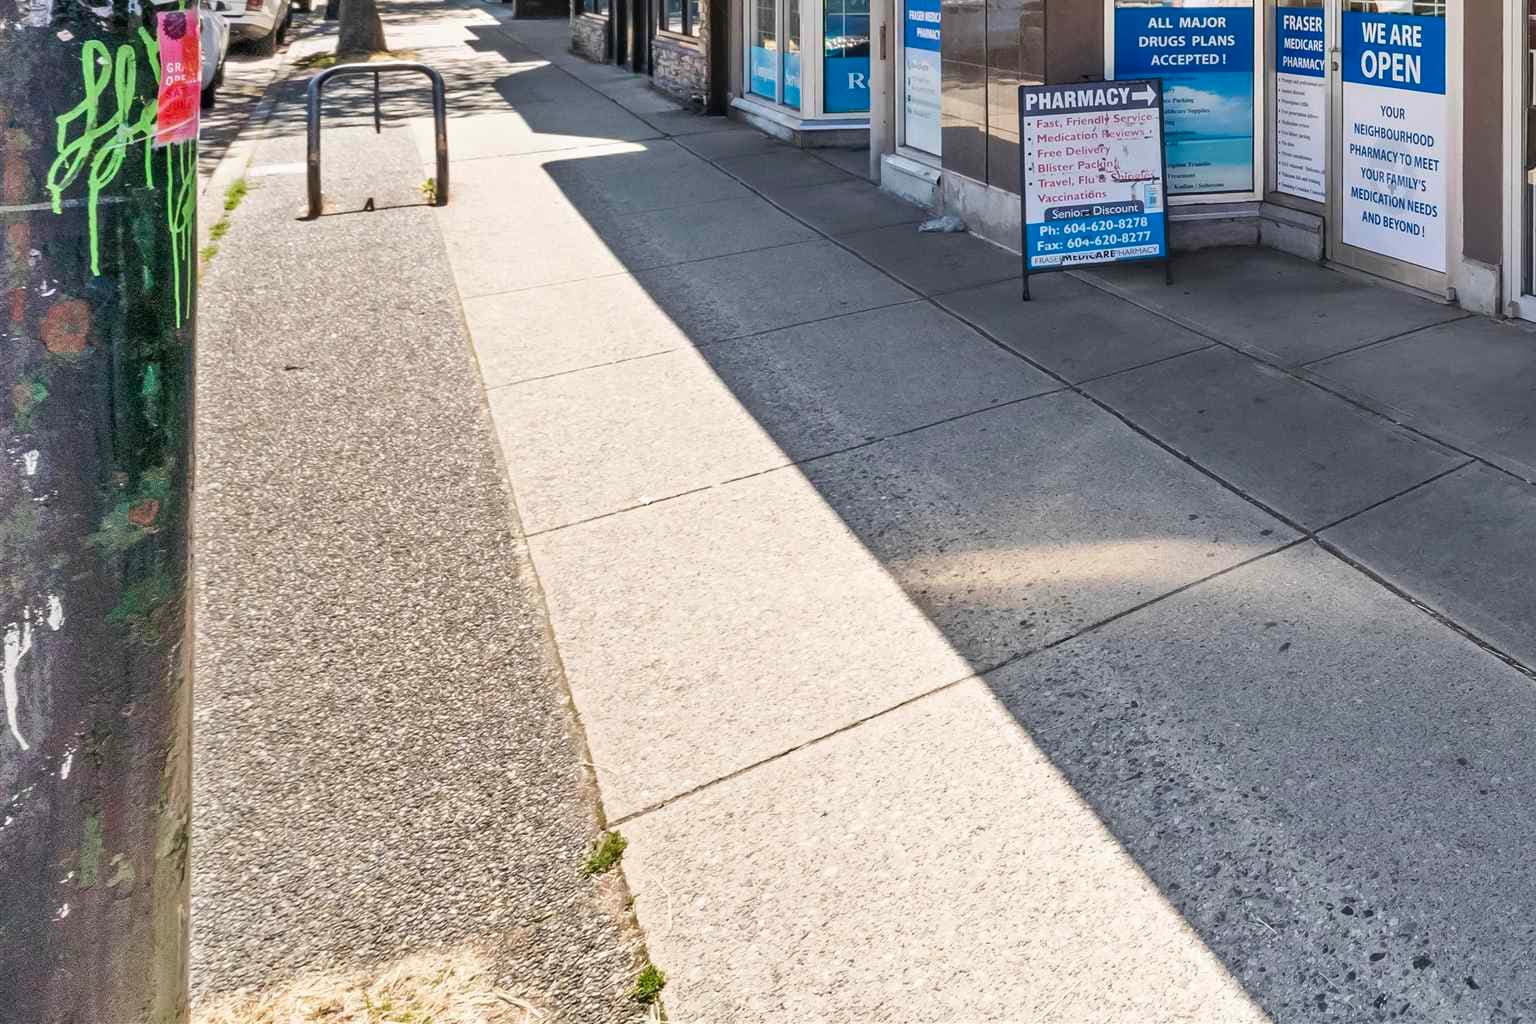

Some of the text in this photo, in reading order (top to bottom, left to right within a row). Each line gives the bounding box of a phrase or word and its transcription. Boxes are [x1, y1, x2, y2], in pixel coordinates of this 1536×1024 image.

[1147, 16, 1226, 29] ALL MAJOR
[1283, 14, 1323, 33] FRASER
[1138, 34, 1235, 48] DRUGS PLANS
[1361, 21, 1423, 48] WE ARE
[1283, 37, 1324, 52] MEDICARE
[1282, 56, 1325, 72] PHARMACY
[1360, 50, 1421, 85] OPEN
[1025, 87, 1130, 111] PHARMACY
[1380, 104, 1405, 120] YOUR
[1036, 118, 1063, 129] Fast,
[1066, 112, 1110, 126] Friendly
[1113, 113, 1152, 124] Service
[1036, 129, 1145, 143] Medication Reviews
[1353, 122, 1434, 148] NEIGHBOURHOOD
[1037, 144, 1110, 159] Free Delivery
[1349, 143, 1439, 172] PHARMACY TO MEET
[1038, 162, 1073, 173] Blister
[1039, 177, 1074, 189] Travel,
[1078, 175, 1094, 185] Flu
[1360, 166, 1426, 192] YOUR FAMILY'S
[1038, 190, 1108, 204] Vaccinations
[1350, 185, 1438, 217] MEDICATION NEEDS
[1093, 203, 1139, 216] Discount
[1361, 210, 1381, 226] AND
[1039, 216, 1148, 237] Ph: 604-620-8278
[1037, 231, 1151, 251] Fax: 604-620-8277
